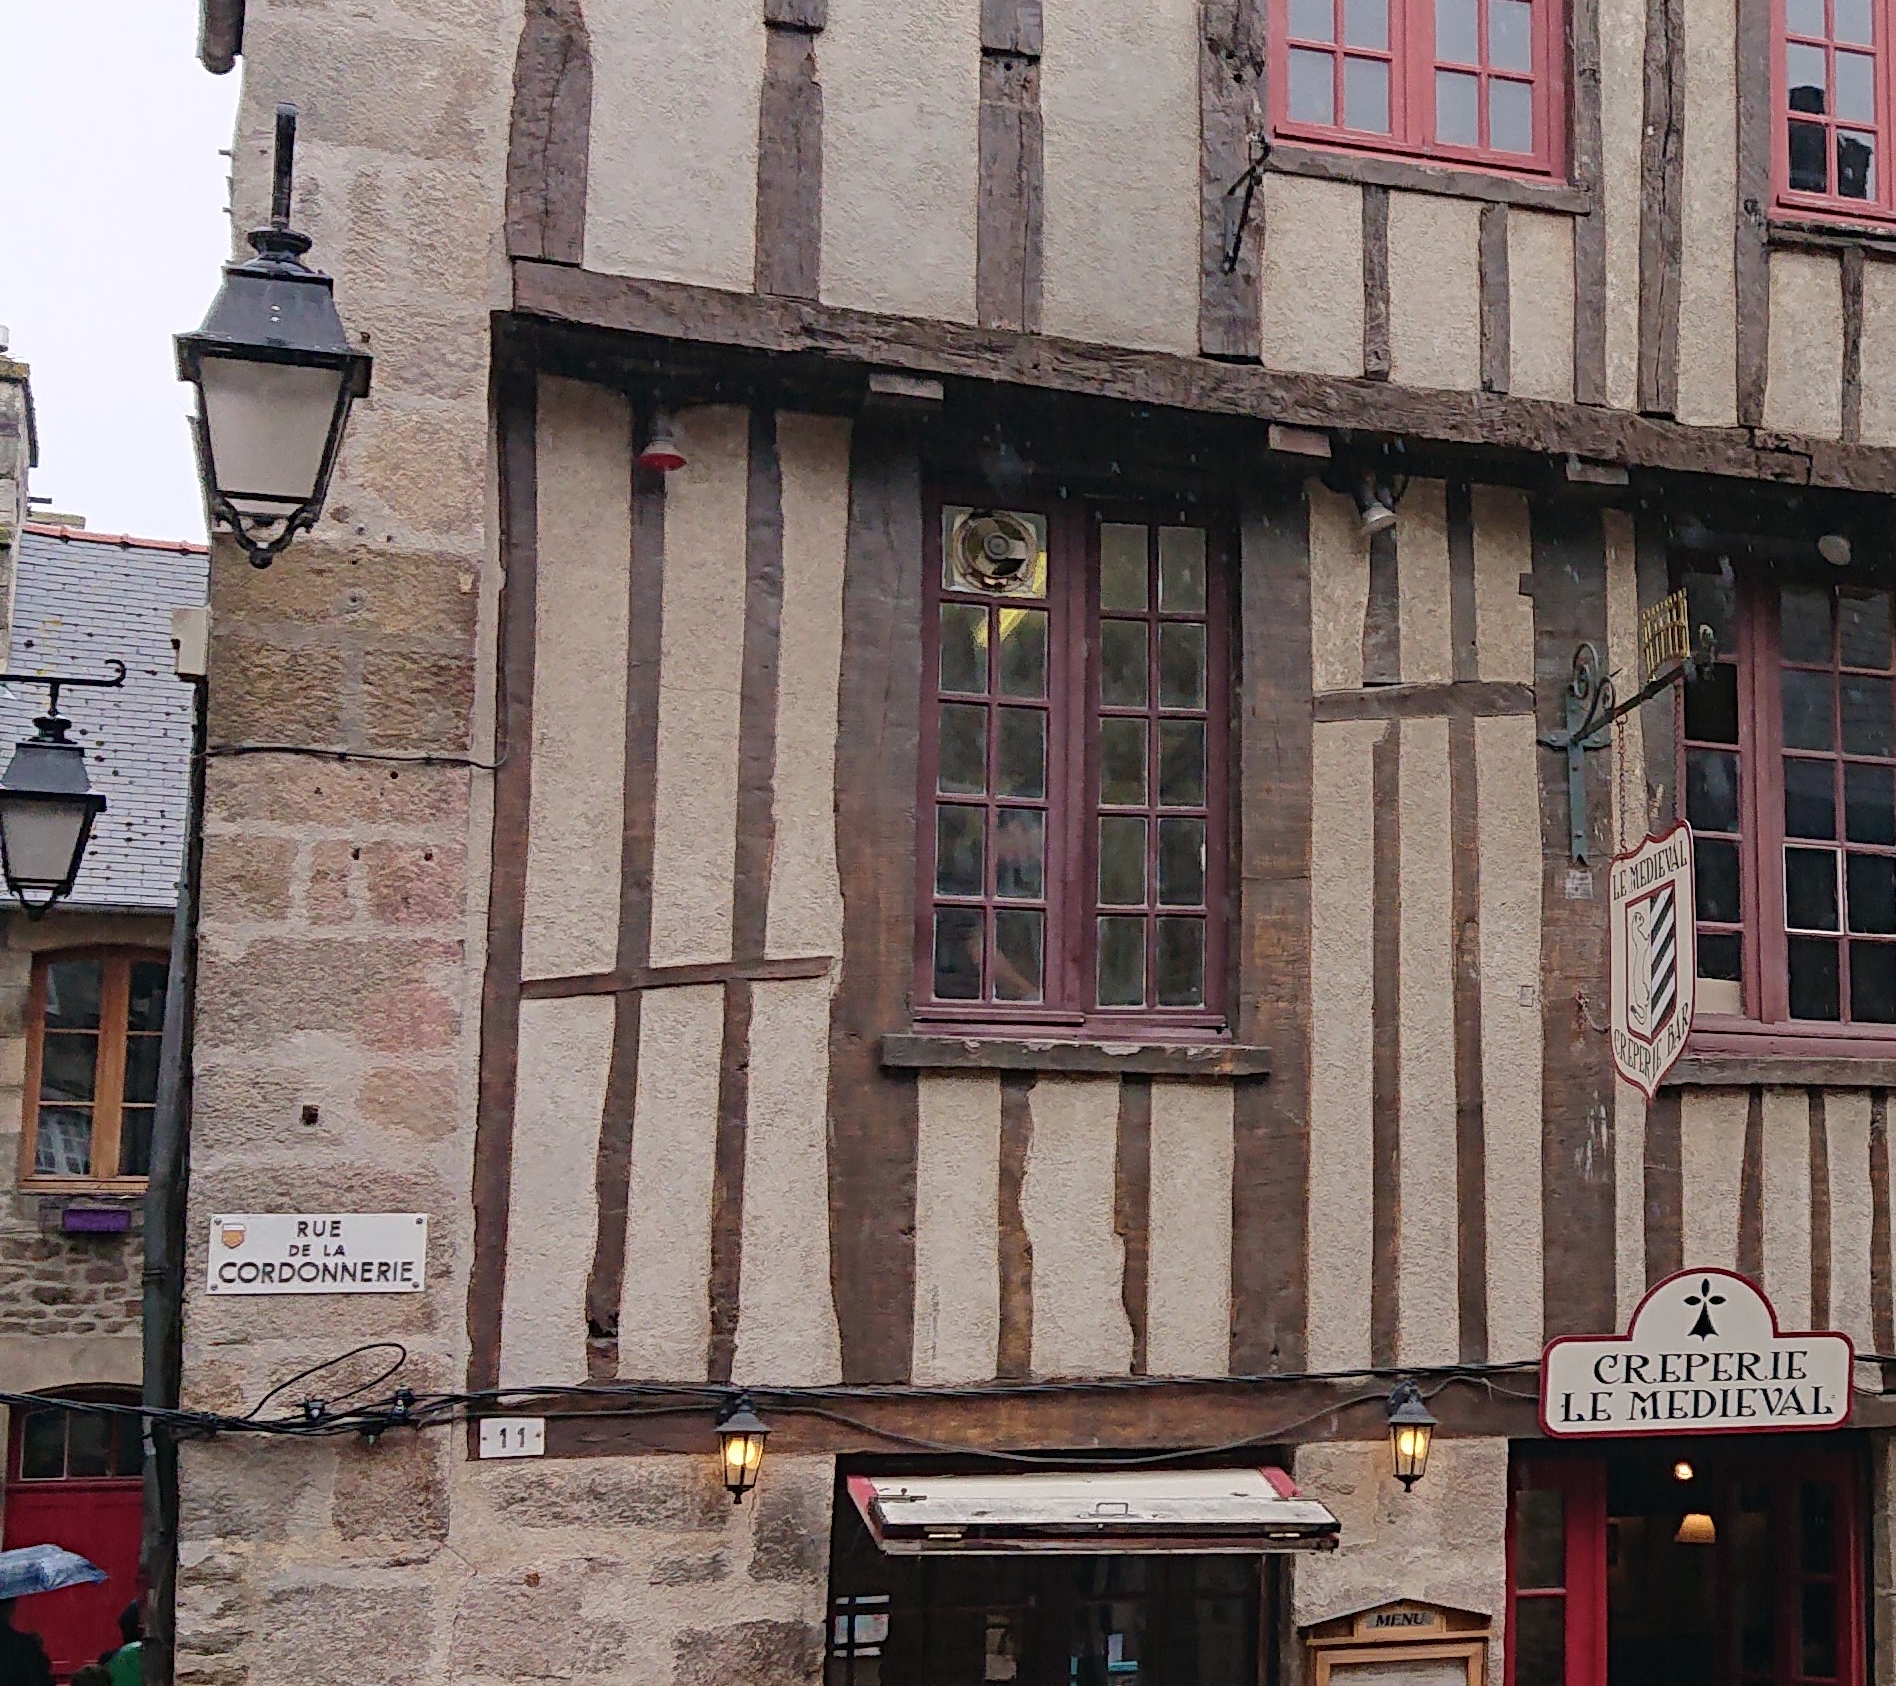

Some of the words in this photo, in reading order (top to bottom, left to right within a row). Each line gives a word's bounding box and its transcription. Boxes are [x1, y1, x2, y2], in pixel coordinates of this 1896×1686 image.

[1612, 869, 1627, 901] LE
[1629, 837, 1687, 892] MEDIEVAL
[1614, 1028, 1662, 1086] CREPERIE
[1666, 1002, 1689, 1057] BAR
[296, 1220, 342, 1237] RUE
[288, 1244, 311, 1257] DE
[323, 1244, 346, 1257] LA
[218, 1261, 415, 1283] CORDONNERIE
[1594, 1350, 1808, 1385] CREPERIE
[1560, 1392, 1613, 1423] LE
[1626, 1385, 1833, 1421] MEDIEVAL
[500, 1427, 525, 1449] 11
[1375, 1612, 1426, 1627] MENU
